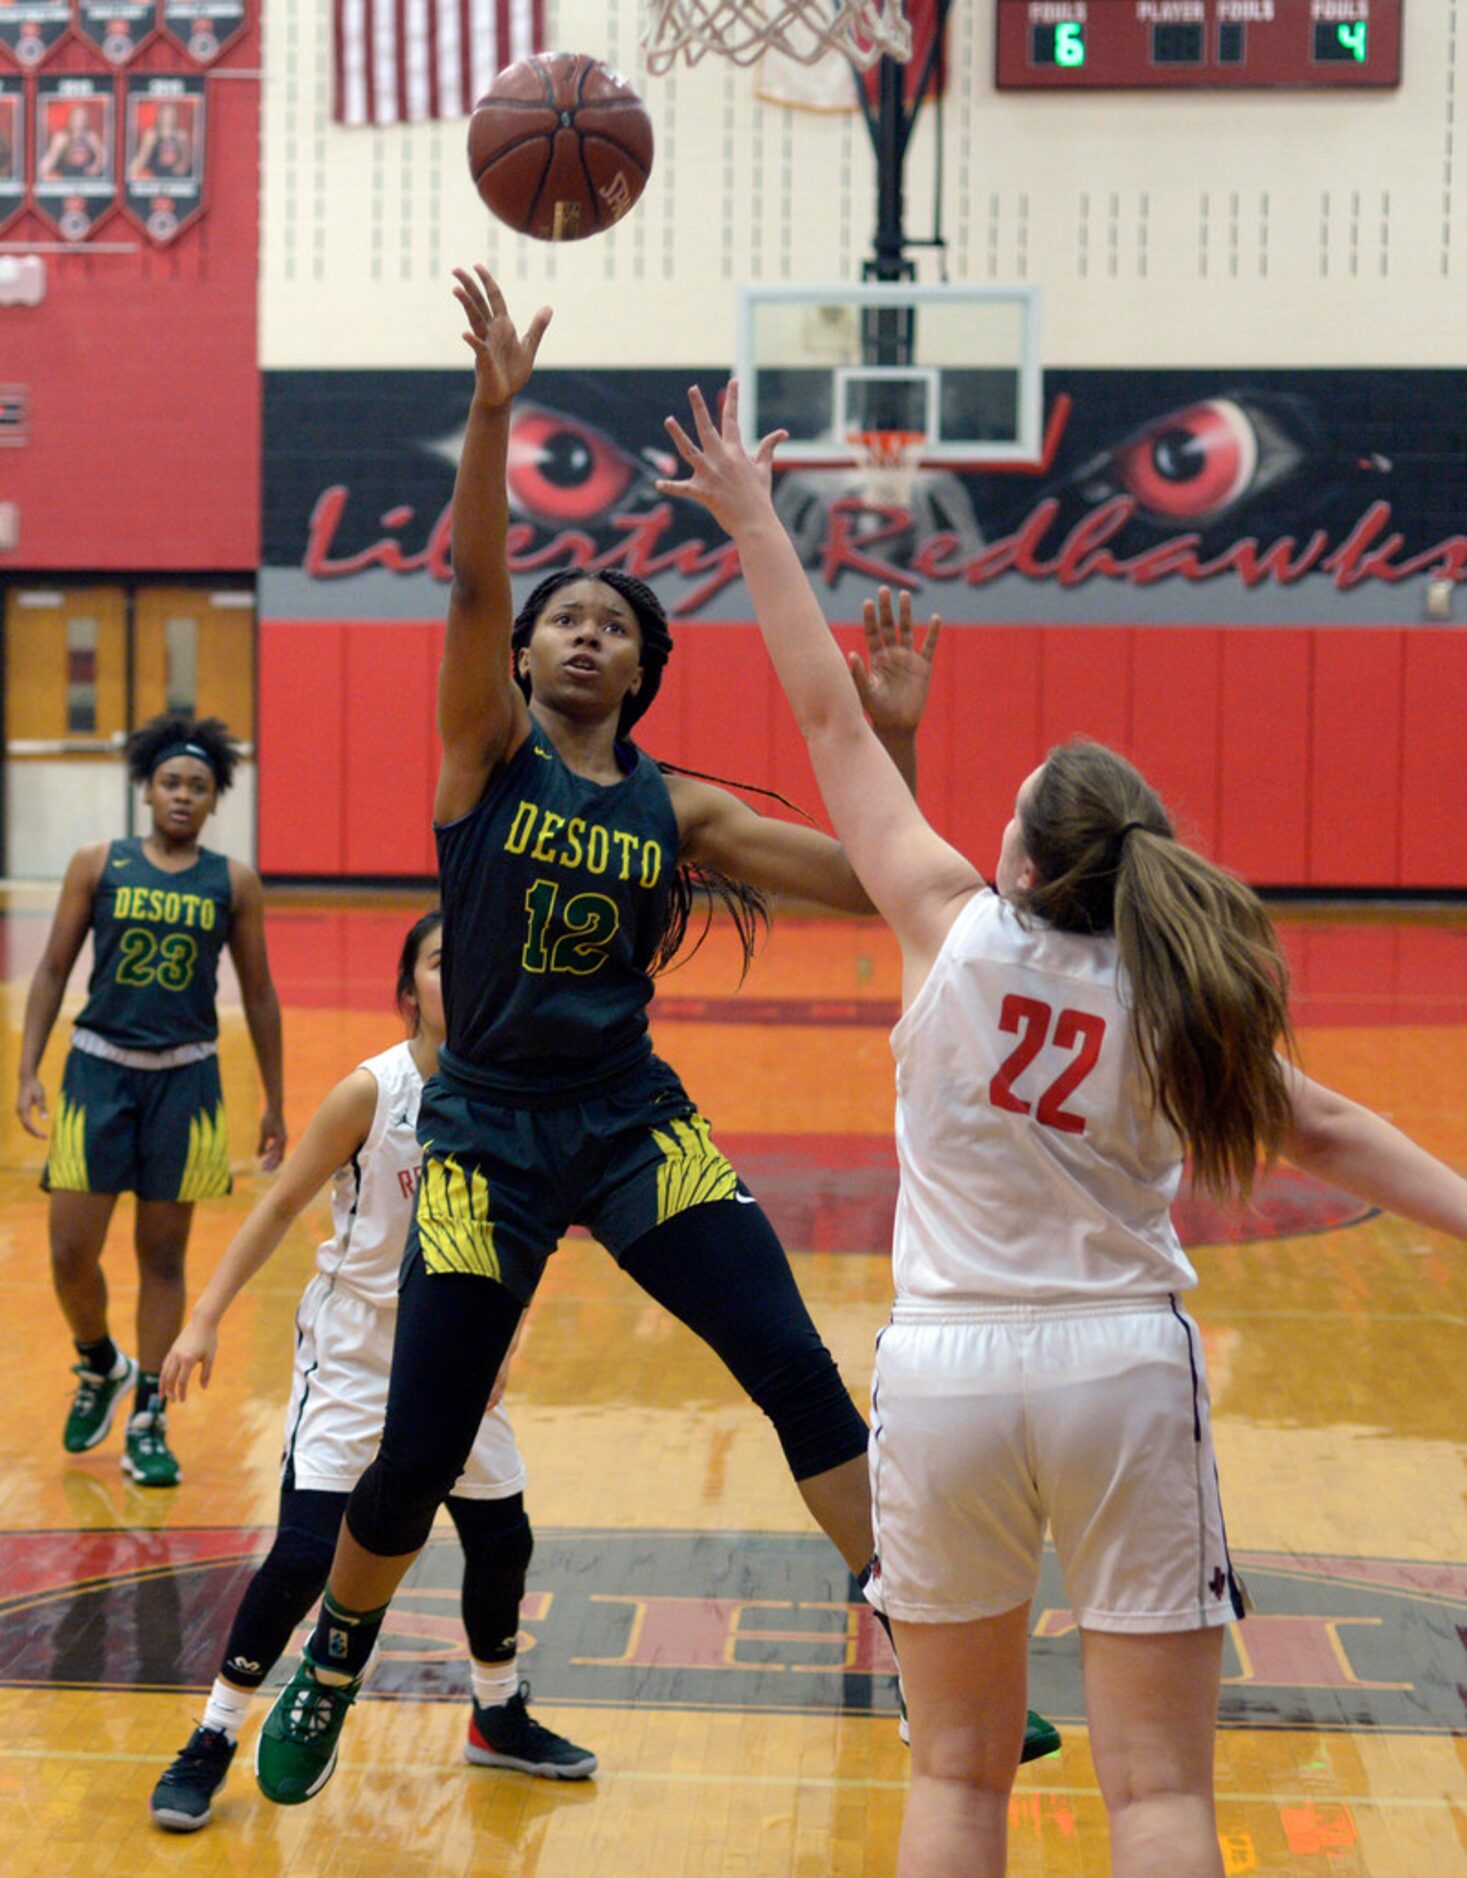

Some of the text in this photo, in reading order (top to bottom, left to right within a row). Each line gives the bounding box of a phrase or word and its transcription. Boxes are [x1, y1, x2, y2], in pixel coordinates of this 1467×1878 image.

[1027, 1, 1087, 22] FOULS
[1136, 0, 1275, 22] PLAYER FOULS
[1310, 0, 1369, 20] FOULS
[1055, 21, 1085, 67] 6
[1337, 20, 1367, 63] 4
[504, 800, 662, 889] DESOTO
[114, 886, 216, 931] DESOTO
[521, 878, 620, 976] 12
[115, 927, 198, 992] 23
[989, 993, 1107, 1135] 22
